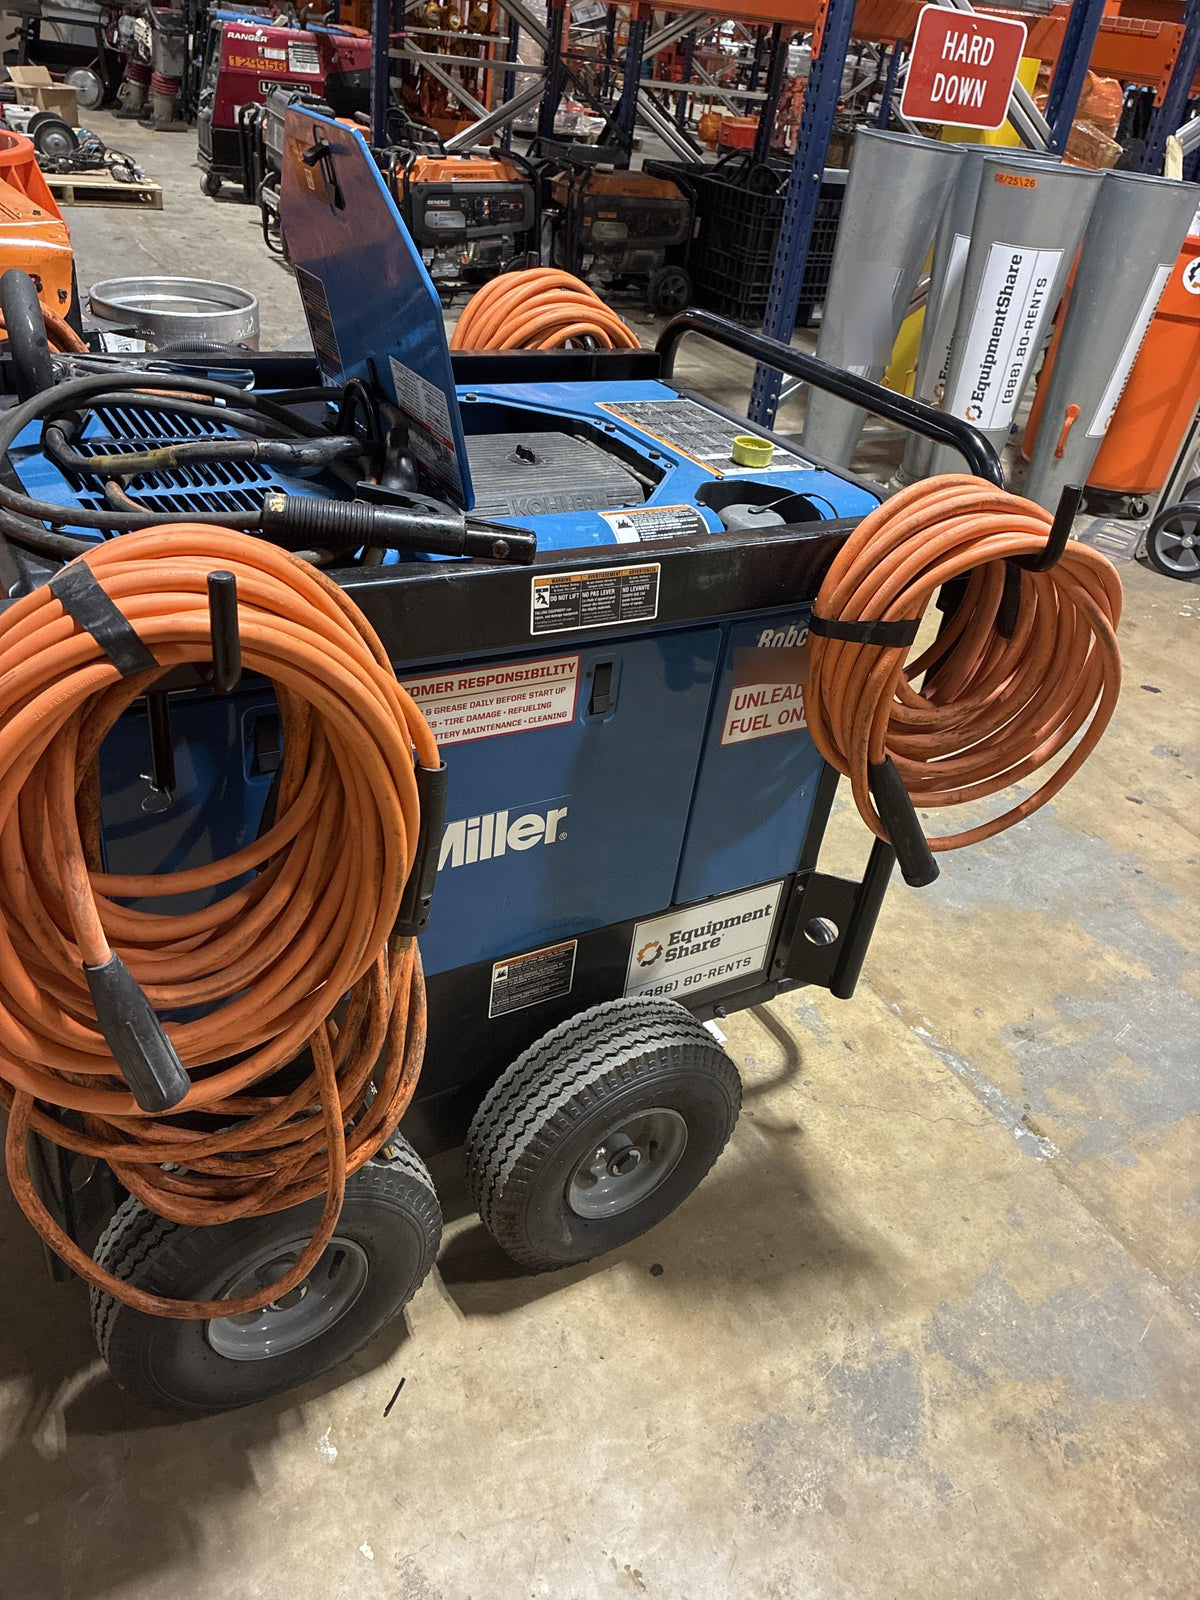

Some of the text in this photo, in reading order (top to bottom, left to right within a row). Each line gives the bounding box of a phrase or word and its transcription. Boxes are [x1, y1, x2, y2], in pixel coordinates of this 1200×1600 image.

[227, 32, 268, 42] RANGER
[941, 30, 995, 66] HARD
[231, 56, 286, 72] 129956
[930, 73, 988, 108] DOWN
[970, 254, 1023, 403] EquipmentShare
[1002, 277, 1048, 405] (888) 80-RENTS
[513, 493, 599, 517] KOHLER
[569, 592, 580, 600] LIFT
[458, 662, 576, 690] RESPONSIBILITY
[434, 704, 468, 715] GREASE
[469, 698, 495, 709] DAILY
[496, 693, 528, 704] BEFORE
[529, 689, 555, 699] START
[556, 686, 566, 695] UP
[444, 715, 464, 726] TIRE
[466, 710, 502, 722] DAMAGE
[507, 702, 552, 715] REFUELING
[462, 719, 522, 736] MAINTENANCE
[528, 711, 568, 724] CLEANING
[729, 713, 772, 736] FUEL
[667, 904, 773, 946] Equipment
[665, 937, 721, 963] Share
[683, 956, 752, 987] 80-RENTS
